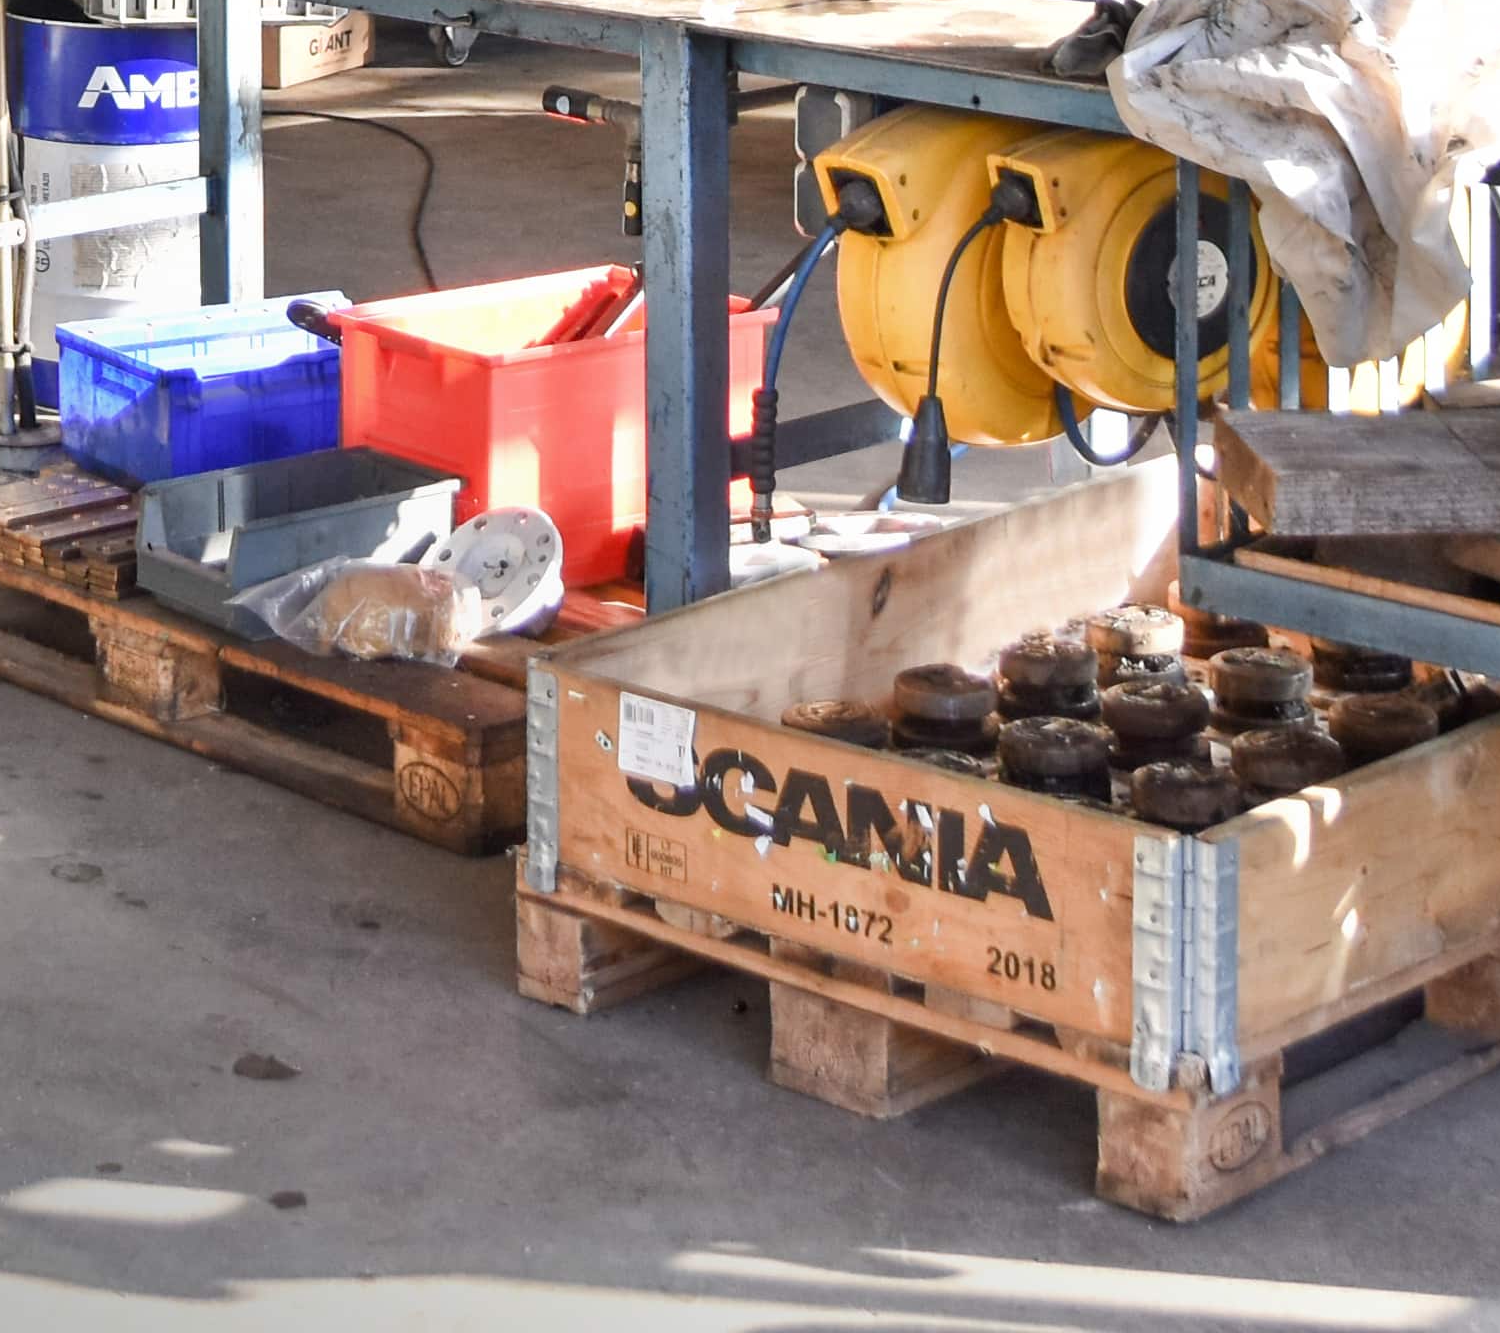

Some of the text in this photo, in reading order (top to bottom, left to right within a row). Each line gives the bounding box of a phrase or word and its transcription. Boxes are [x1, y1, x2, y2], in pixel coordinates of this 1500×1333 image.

[77, 65, 200, 110] AMB
[770, 882, 896, 946] MH-1872
[986, 946, 1058, 992] 2018
